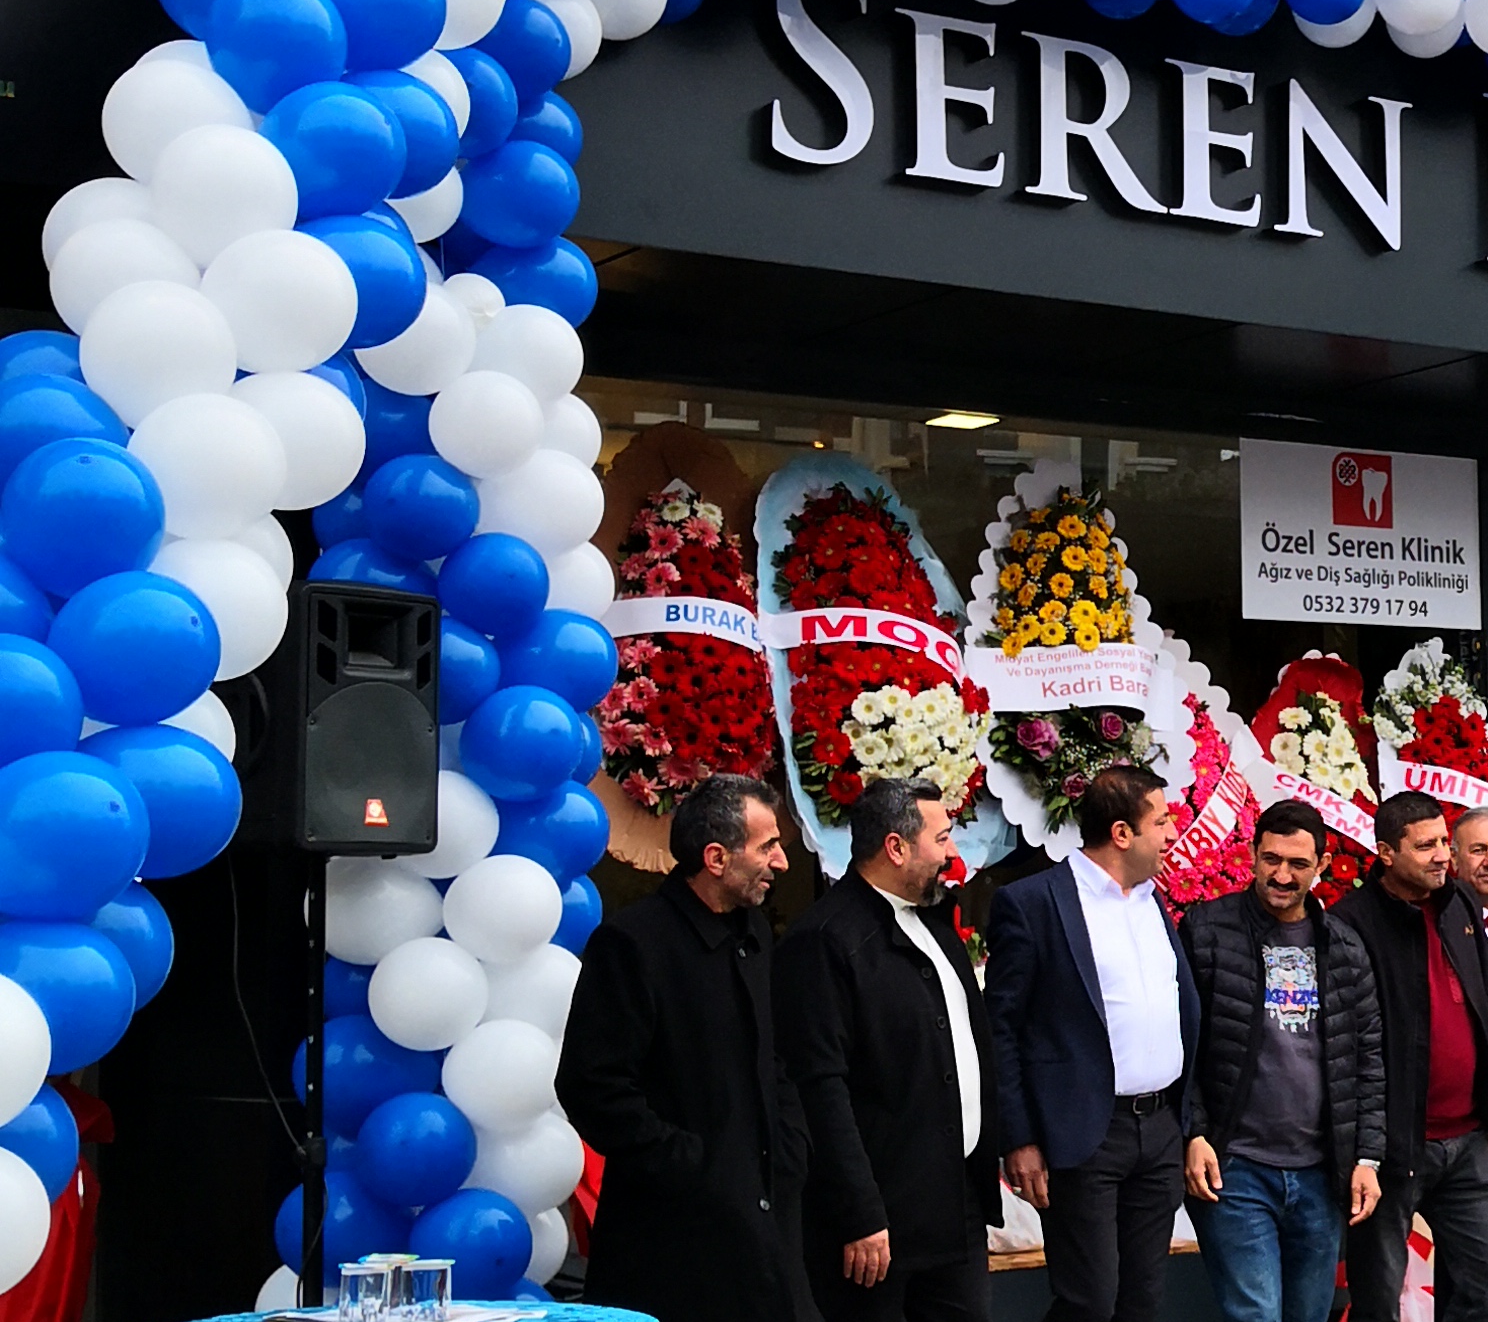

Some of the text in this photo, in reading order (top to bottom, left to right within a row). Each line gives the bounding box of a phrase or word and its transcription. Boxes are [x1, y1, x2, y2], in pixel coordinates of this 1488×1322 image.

[1261, 522, 1466, 565] Özel Seren Klinik
[1258, 562, 1469, 593] Ağız ve Diş Sağlığı Polikliniği
[665, 603, 746, 635] BURAK
[1303, 595, 1428, 617] 0532 379 17 94
[1006, 667, 1021, 677] Ve
[1041, 675, 1101, 698] Kadri
[1217, 760, 1247, 813] KIDS
[1276, 773, 1348, 815] CMK
